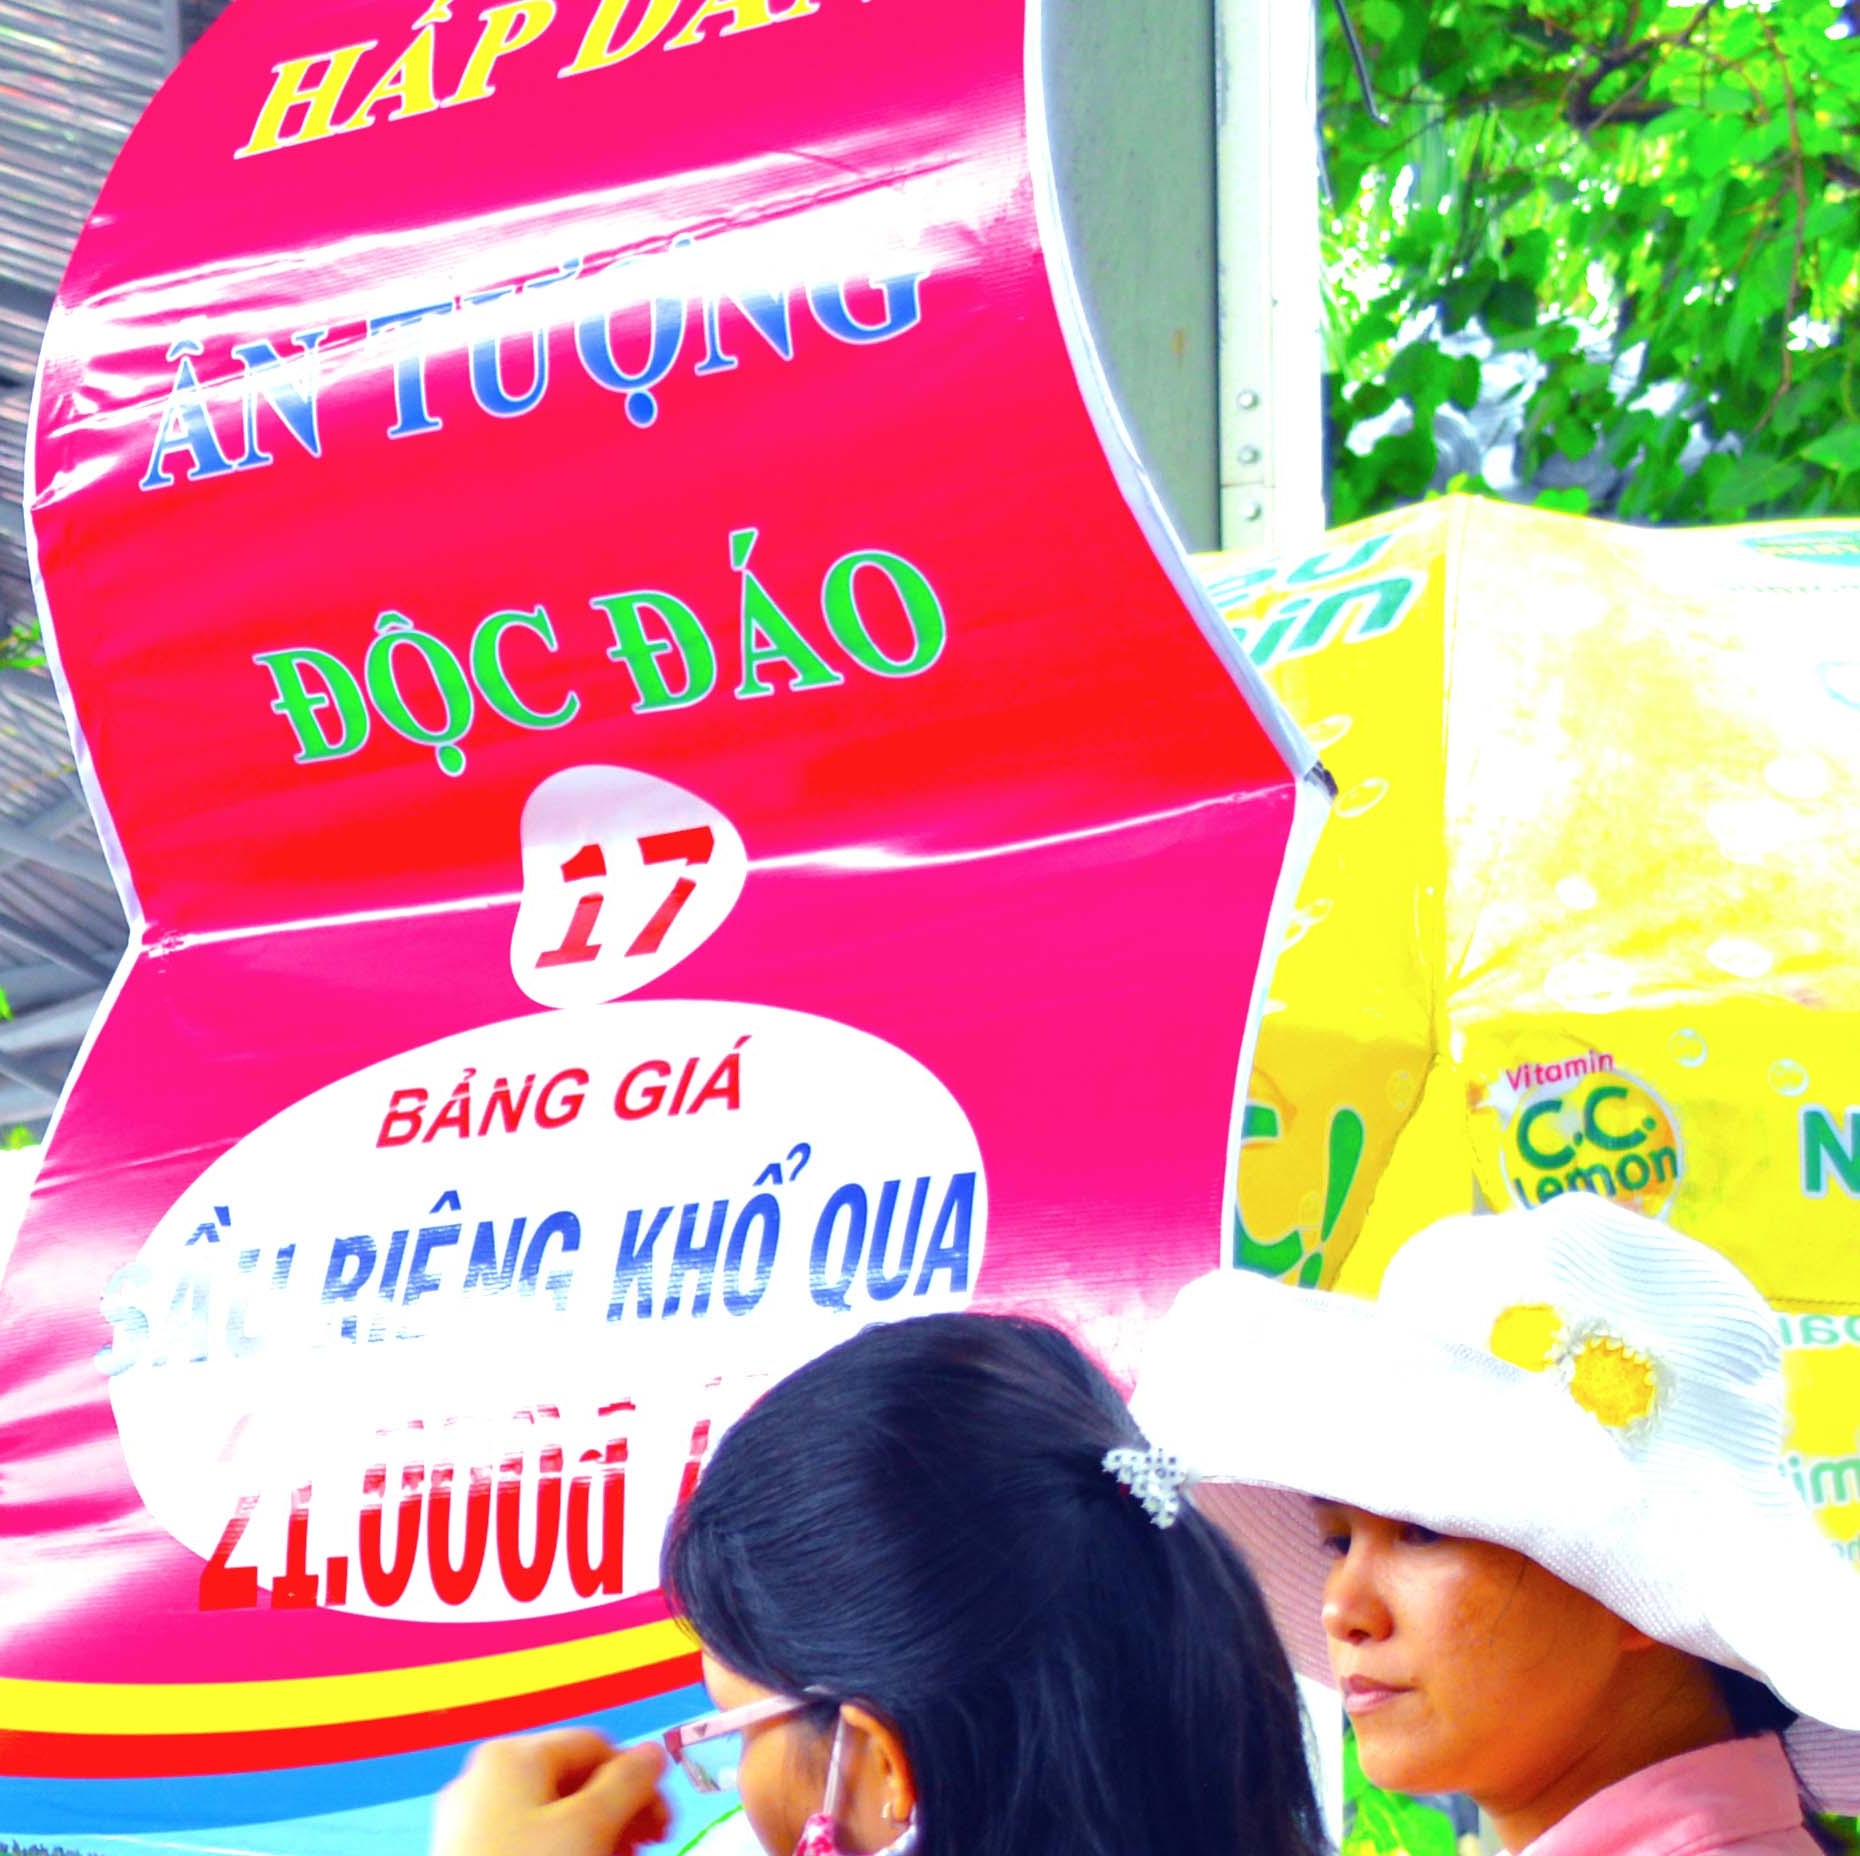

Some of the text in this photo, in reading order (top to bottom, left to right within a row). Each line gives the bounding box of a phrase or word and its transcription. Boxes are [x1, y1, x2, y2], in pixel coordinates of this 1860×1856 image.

[254, 528, 947, 777] ĐỘC ĐÁO
[534, 825, 716, 970] 17
[376, 1034, 753, 1148] BẢNG GIÁ
[1506, 1048, 1614, 1091] Vitamin
[1517, 1085, 1657, 1169] C.C.
[606, 1142, 811, 1323] KHỔ
[808, 1171, 977, 1314] QUA
